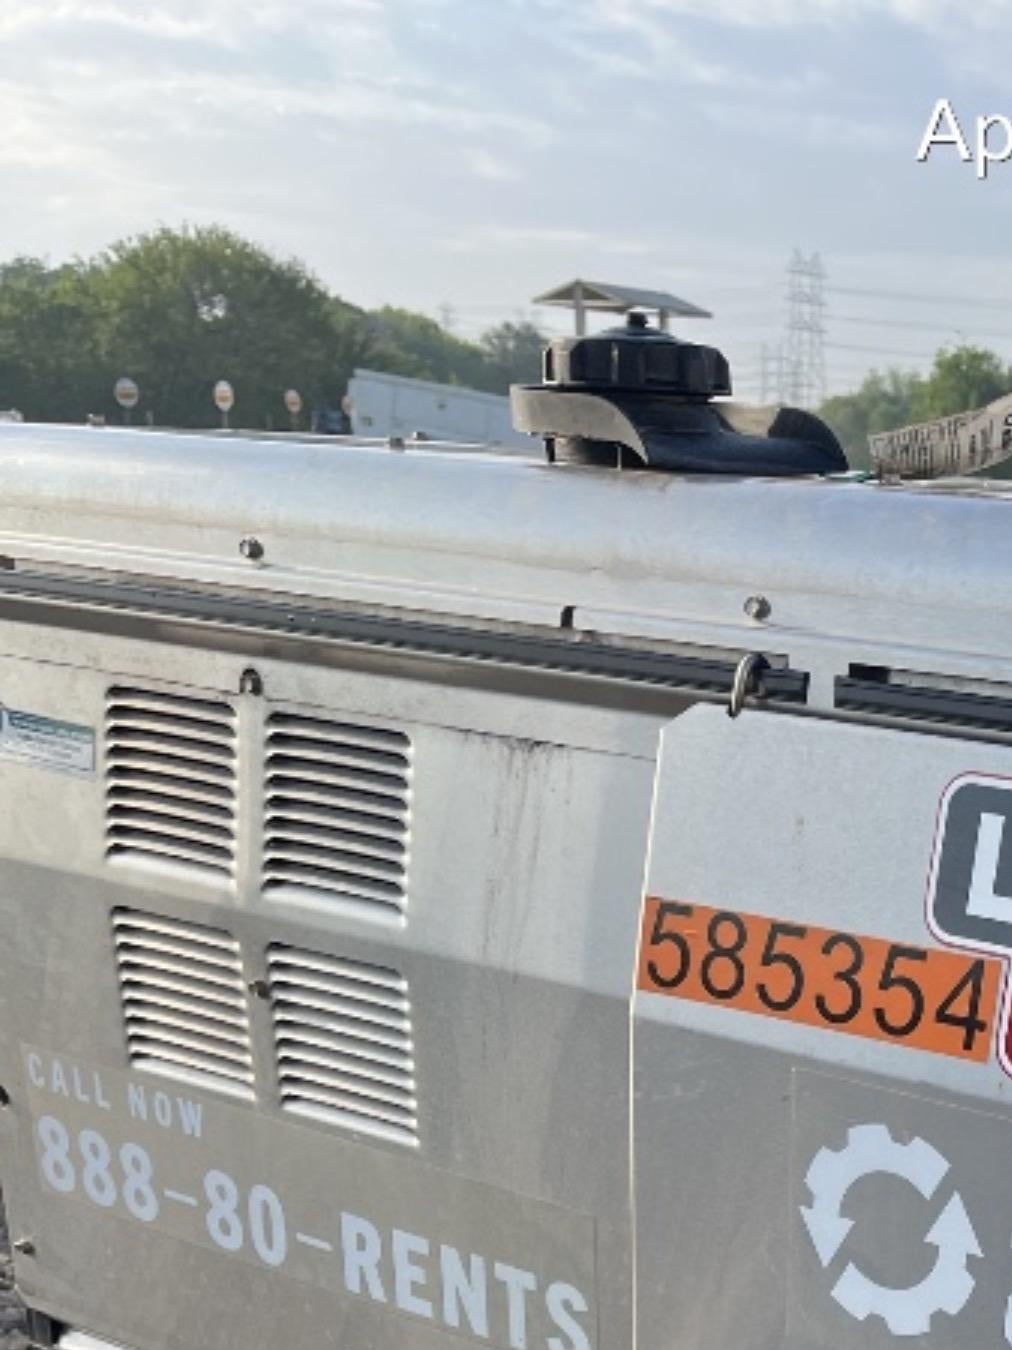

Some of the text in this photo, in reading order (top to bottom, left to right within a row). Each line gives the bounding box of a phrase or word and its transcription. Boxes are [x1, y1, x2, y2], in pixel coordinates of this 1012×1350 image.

[645, 903, 990, 1052] 585354
[28, 1053, 203, 1137] CALL NOW
